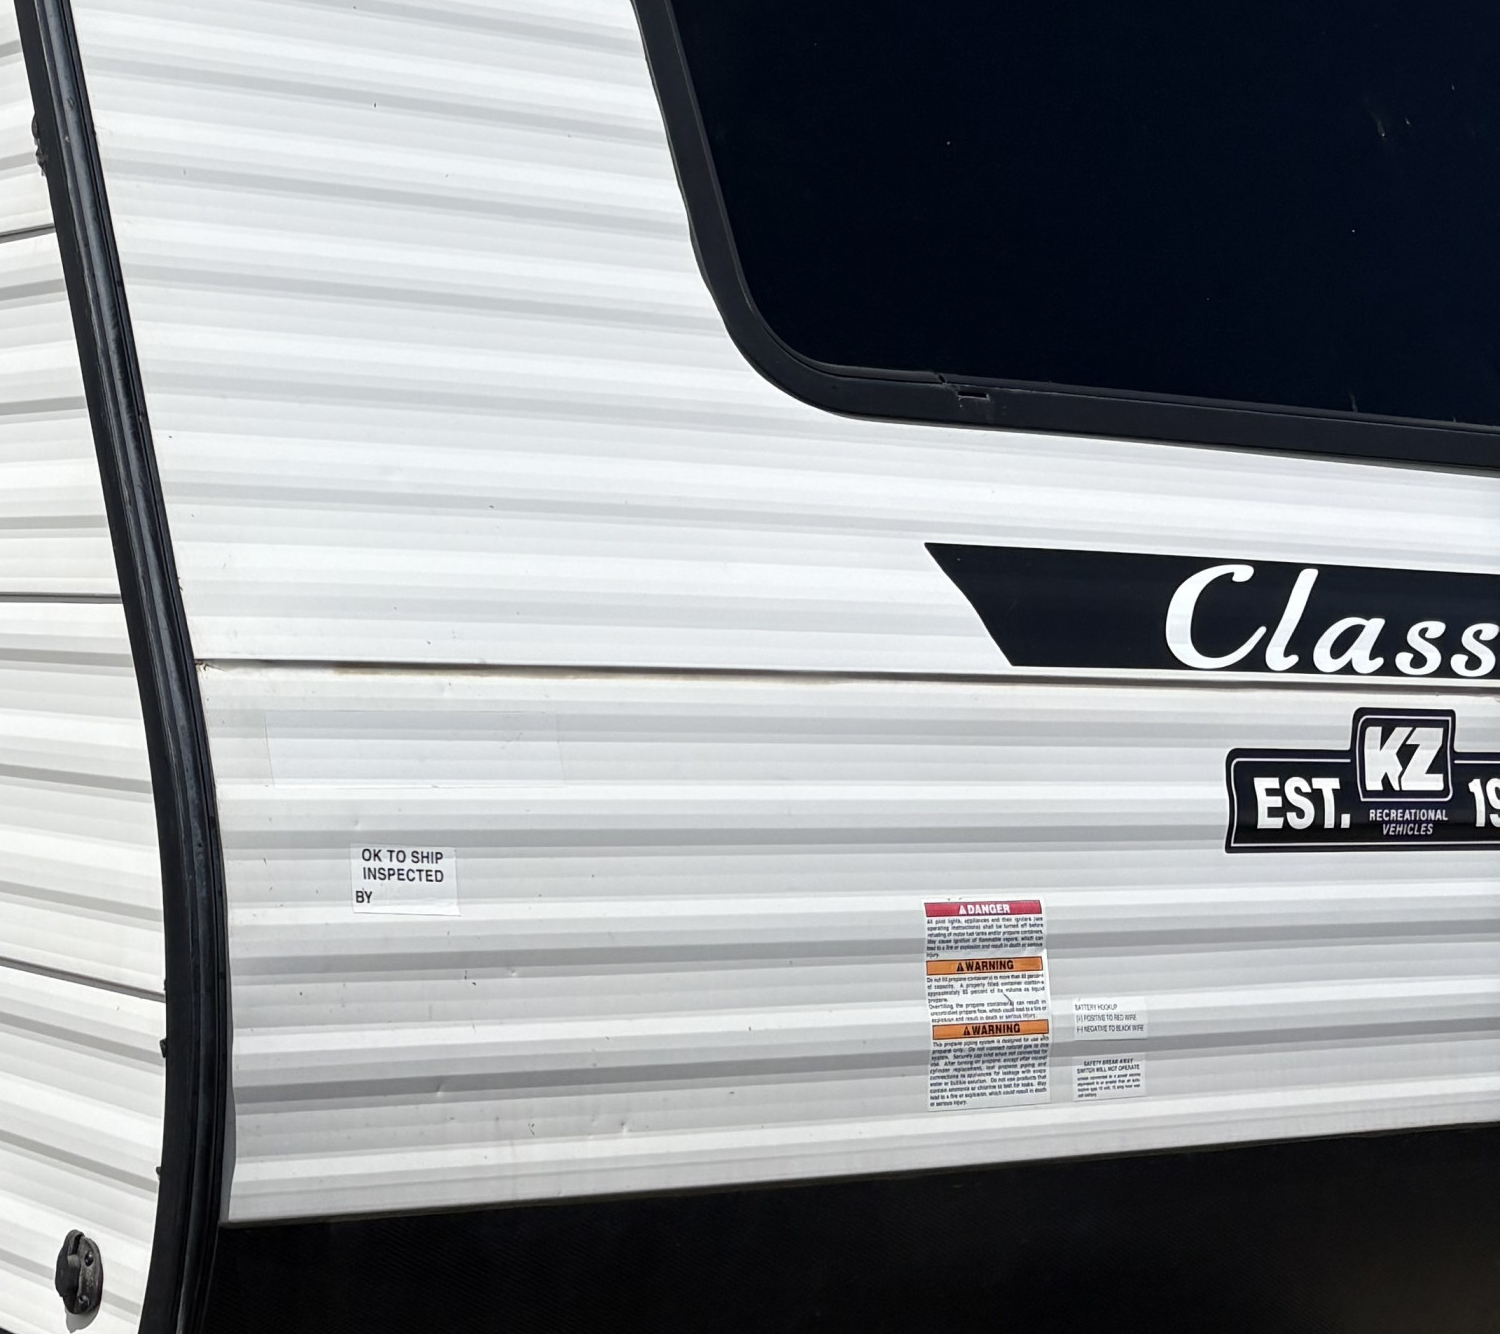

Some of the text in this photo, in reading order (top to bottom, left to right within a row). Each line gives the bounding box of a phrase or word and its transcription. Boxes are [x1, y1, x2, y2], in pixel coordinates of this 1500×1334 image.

[1165, 564, 1500, 677] Class
[1364, 726, 1445, 791] KZ
[1254, 776, 1351, 831] EST.
[1369, 809, 1449, 821] RECREATIONAL
[1382, 823, 1434, 835] VEHICLES
[361, 848, 444, 864] OK TO SHIP
[363, 867, 444, 883] INSPECTED
[355, 890, 373, 903] BY
[967, 903, 1011, 914] DANGER
[965, 960, 1014, 971] WARNING
[972, 1023, 1020, 1035] WARNING
